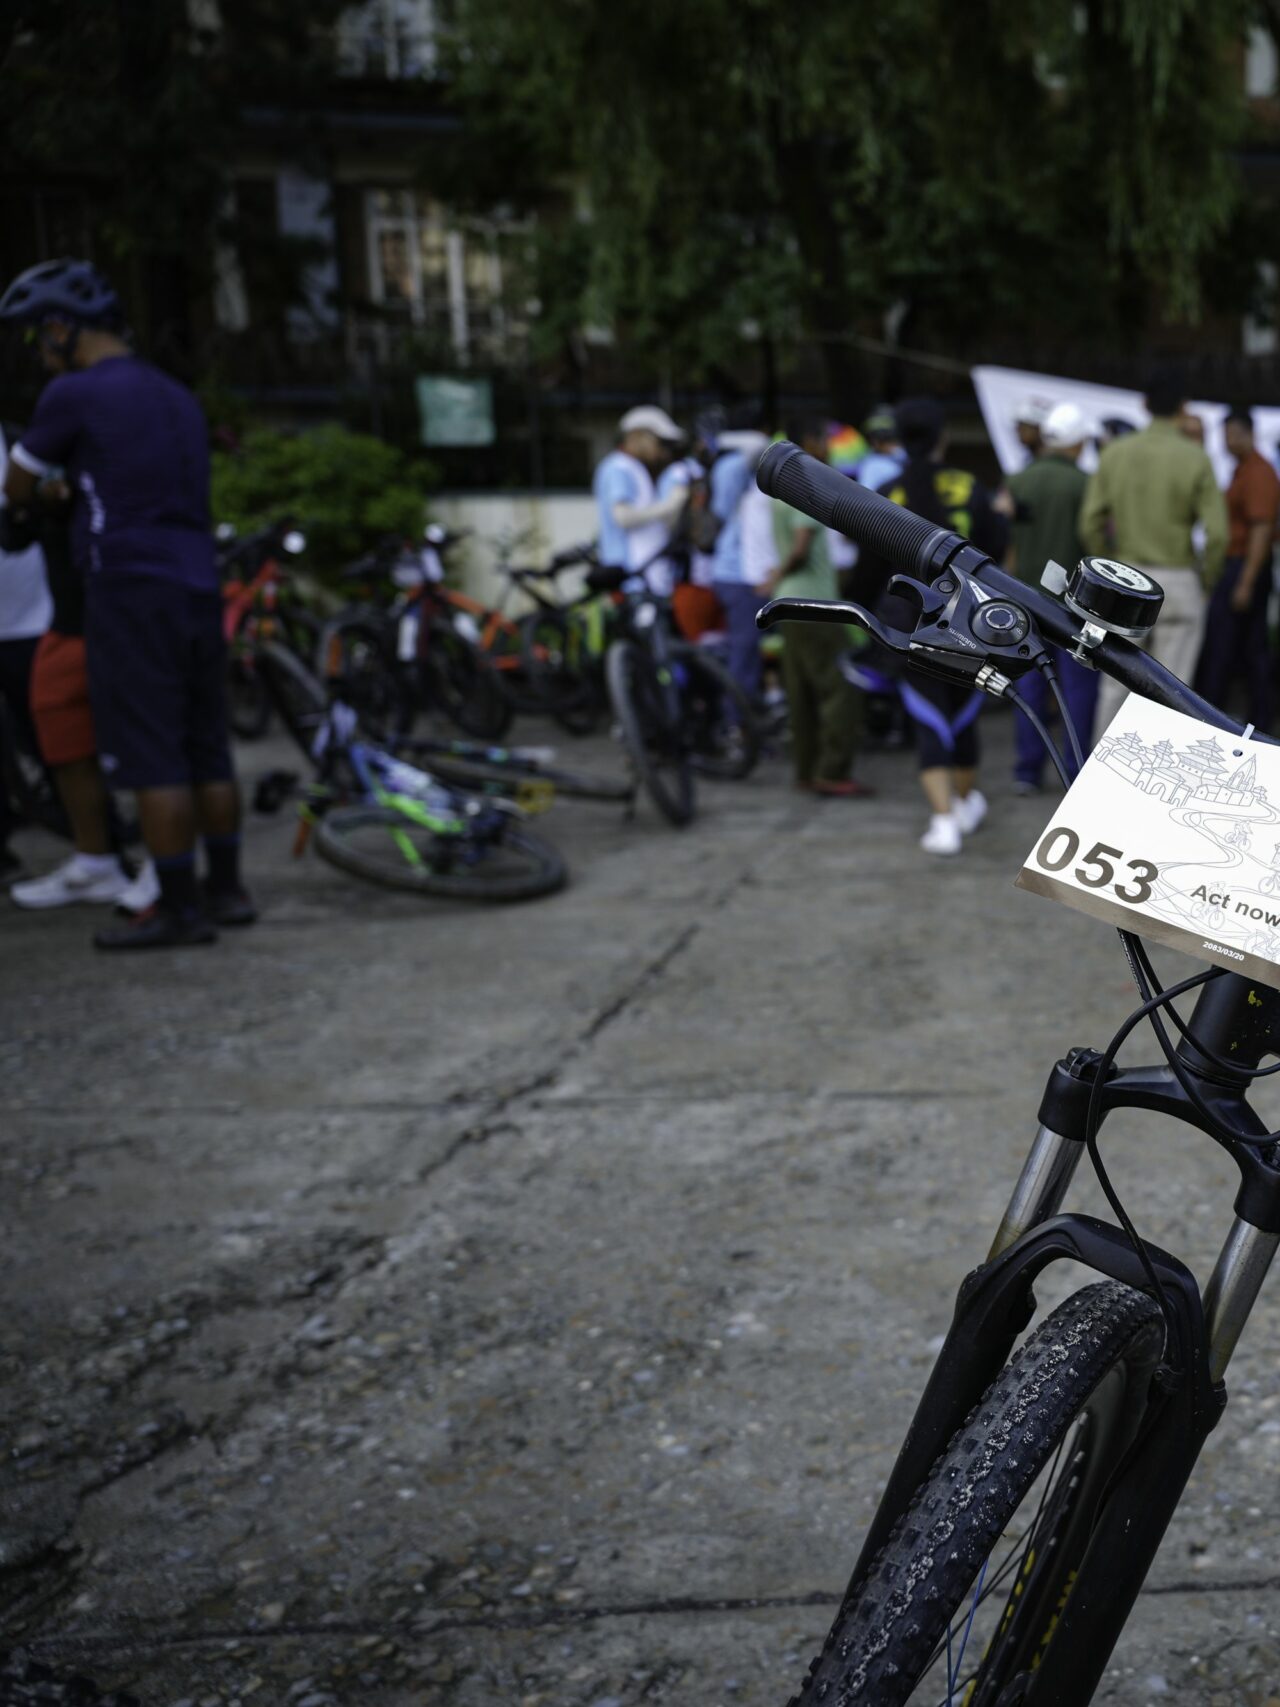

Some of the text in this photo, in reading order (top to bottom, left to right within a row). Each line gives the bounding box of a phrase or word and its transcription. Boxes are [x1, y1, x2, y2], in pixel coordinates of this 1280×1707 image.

[1035, 826, 1159, 905] 053
[1189, 883, 1231, 910] Act
[1202, 941, 1245, 961] 2083/03/20
